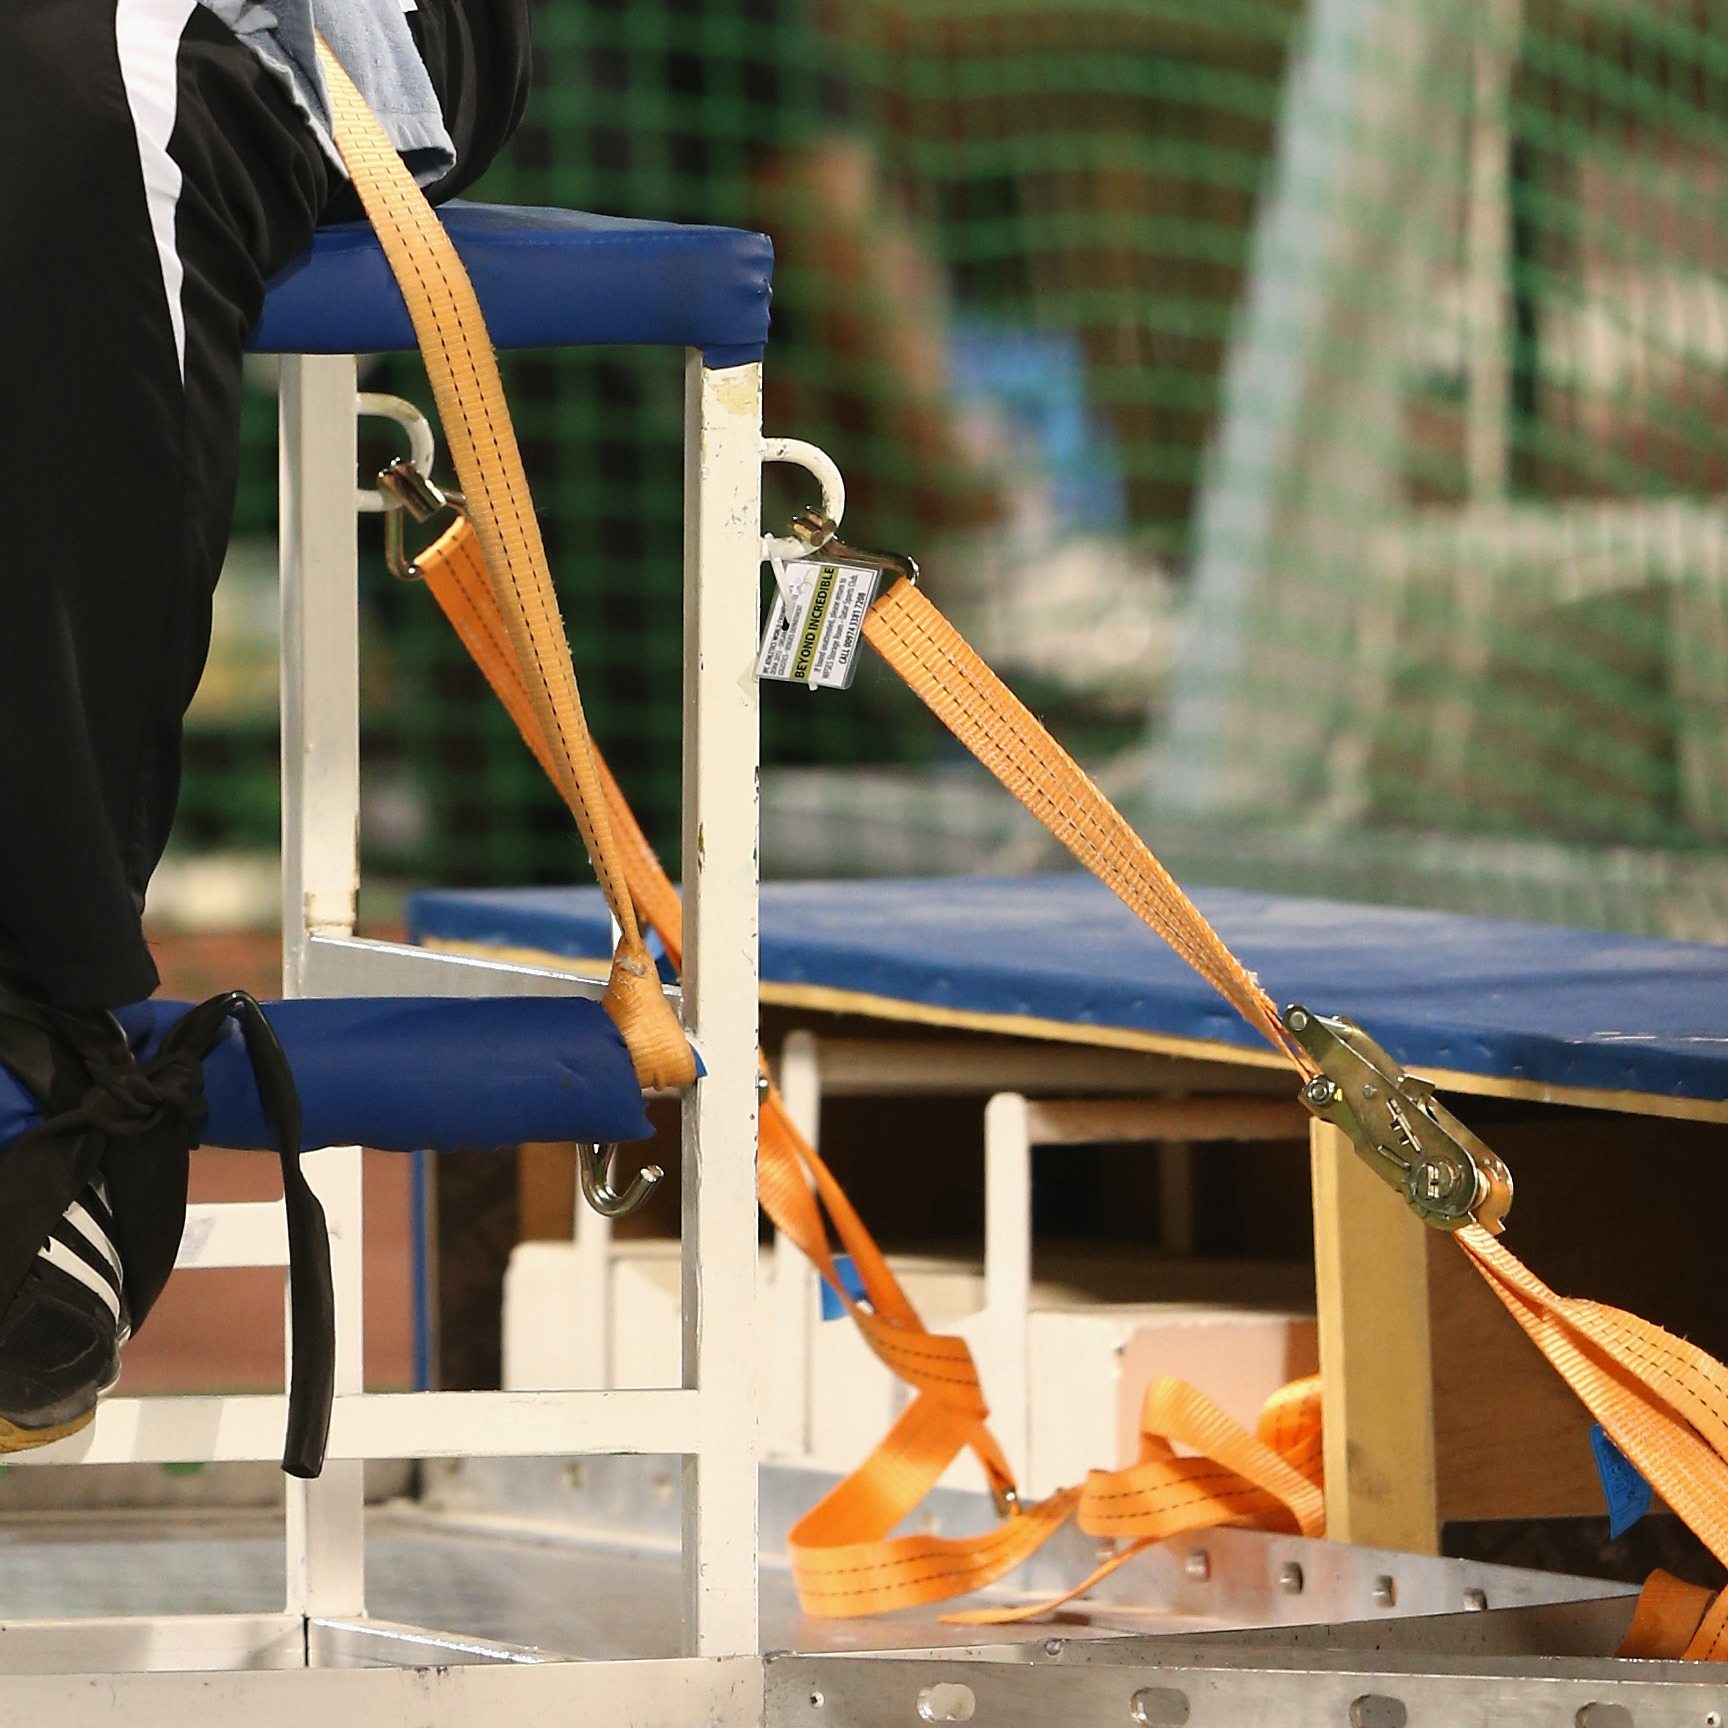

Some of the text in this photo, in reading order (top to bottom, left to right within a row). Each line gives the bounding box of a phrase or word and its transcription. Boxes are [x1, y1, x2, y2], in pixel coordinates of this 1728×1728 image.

[795, 566, 835, 678] BEYOND INCREDIBLE
[839, 648, 849, 664] CALL
